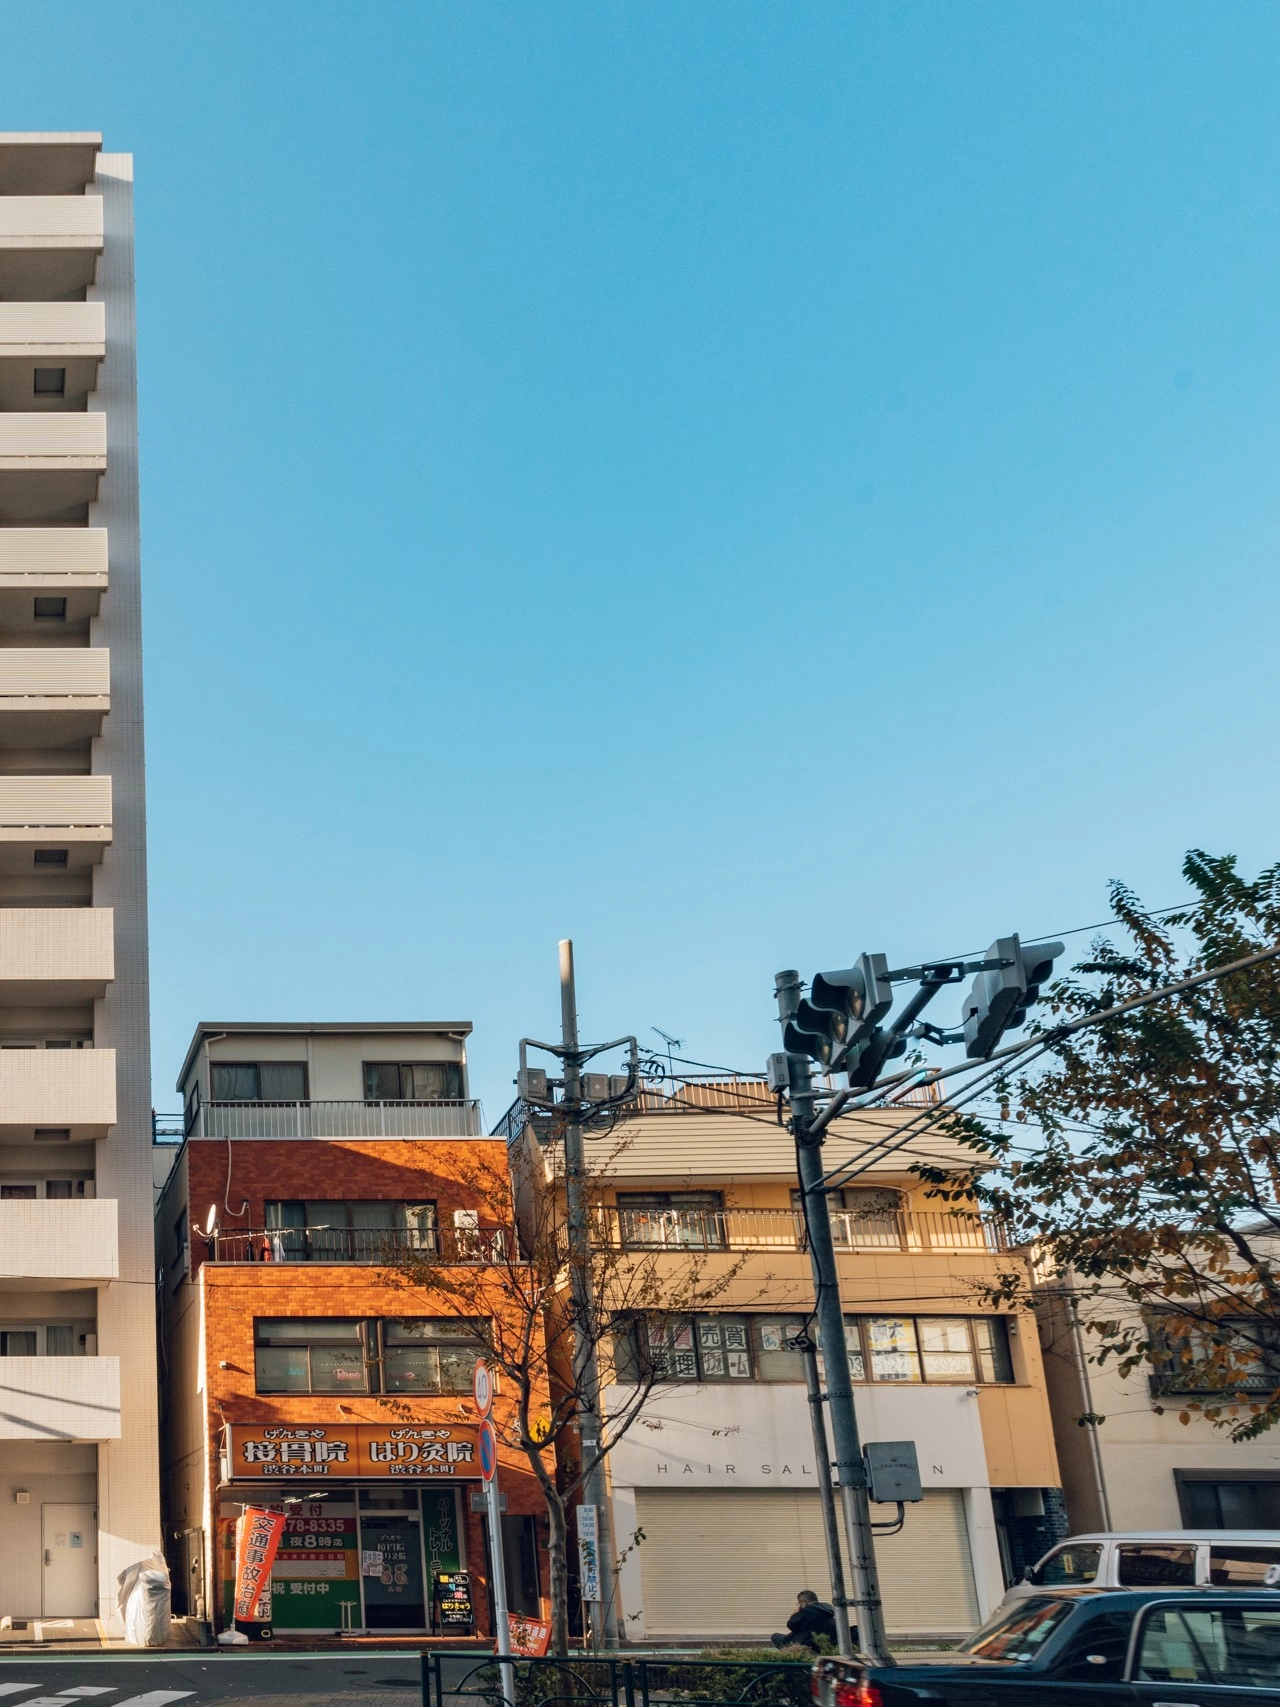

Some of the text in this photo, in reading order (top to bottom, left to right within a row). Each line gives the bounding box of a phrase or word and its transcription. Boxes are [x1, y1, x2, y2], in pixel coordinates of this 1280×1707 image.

[700, 1323, 746, 1348] 売買
[478, 1375, 488, 1400] 40
[264, 1427, 325, 1439] げんきや
[390, 1427, 451, 1439] げんきや
[243, 1441, 349, 1463] 接骨院
[370, 1441, 474, 1463] はり灸院
[263, 1464, 330, 1475] 渋谷本町
[390, 1464, 455, 1475] 渋谷本町
[657, 1464, 736, 1474] HAIR
[237, 1515, 276, 1616] 交通事故治療
[290, 1582, 329, 1594] 受付中
[441, 1602, 471, 1610] はりきゅう
